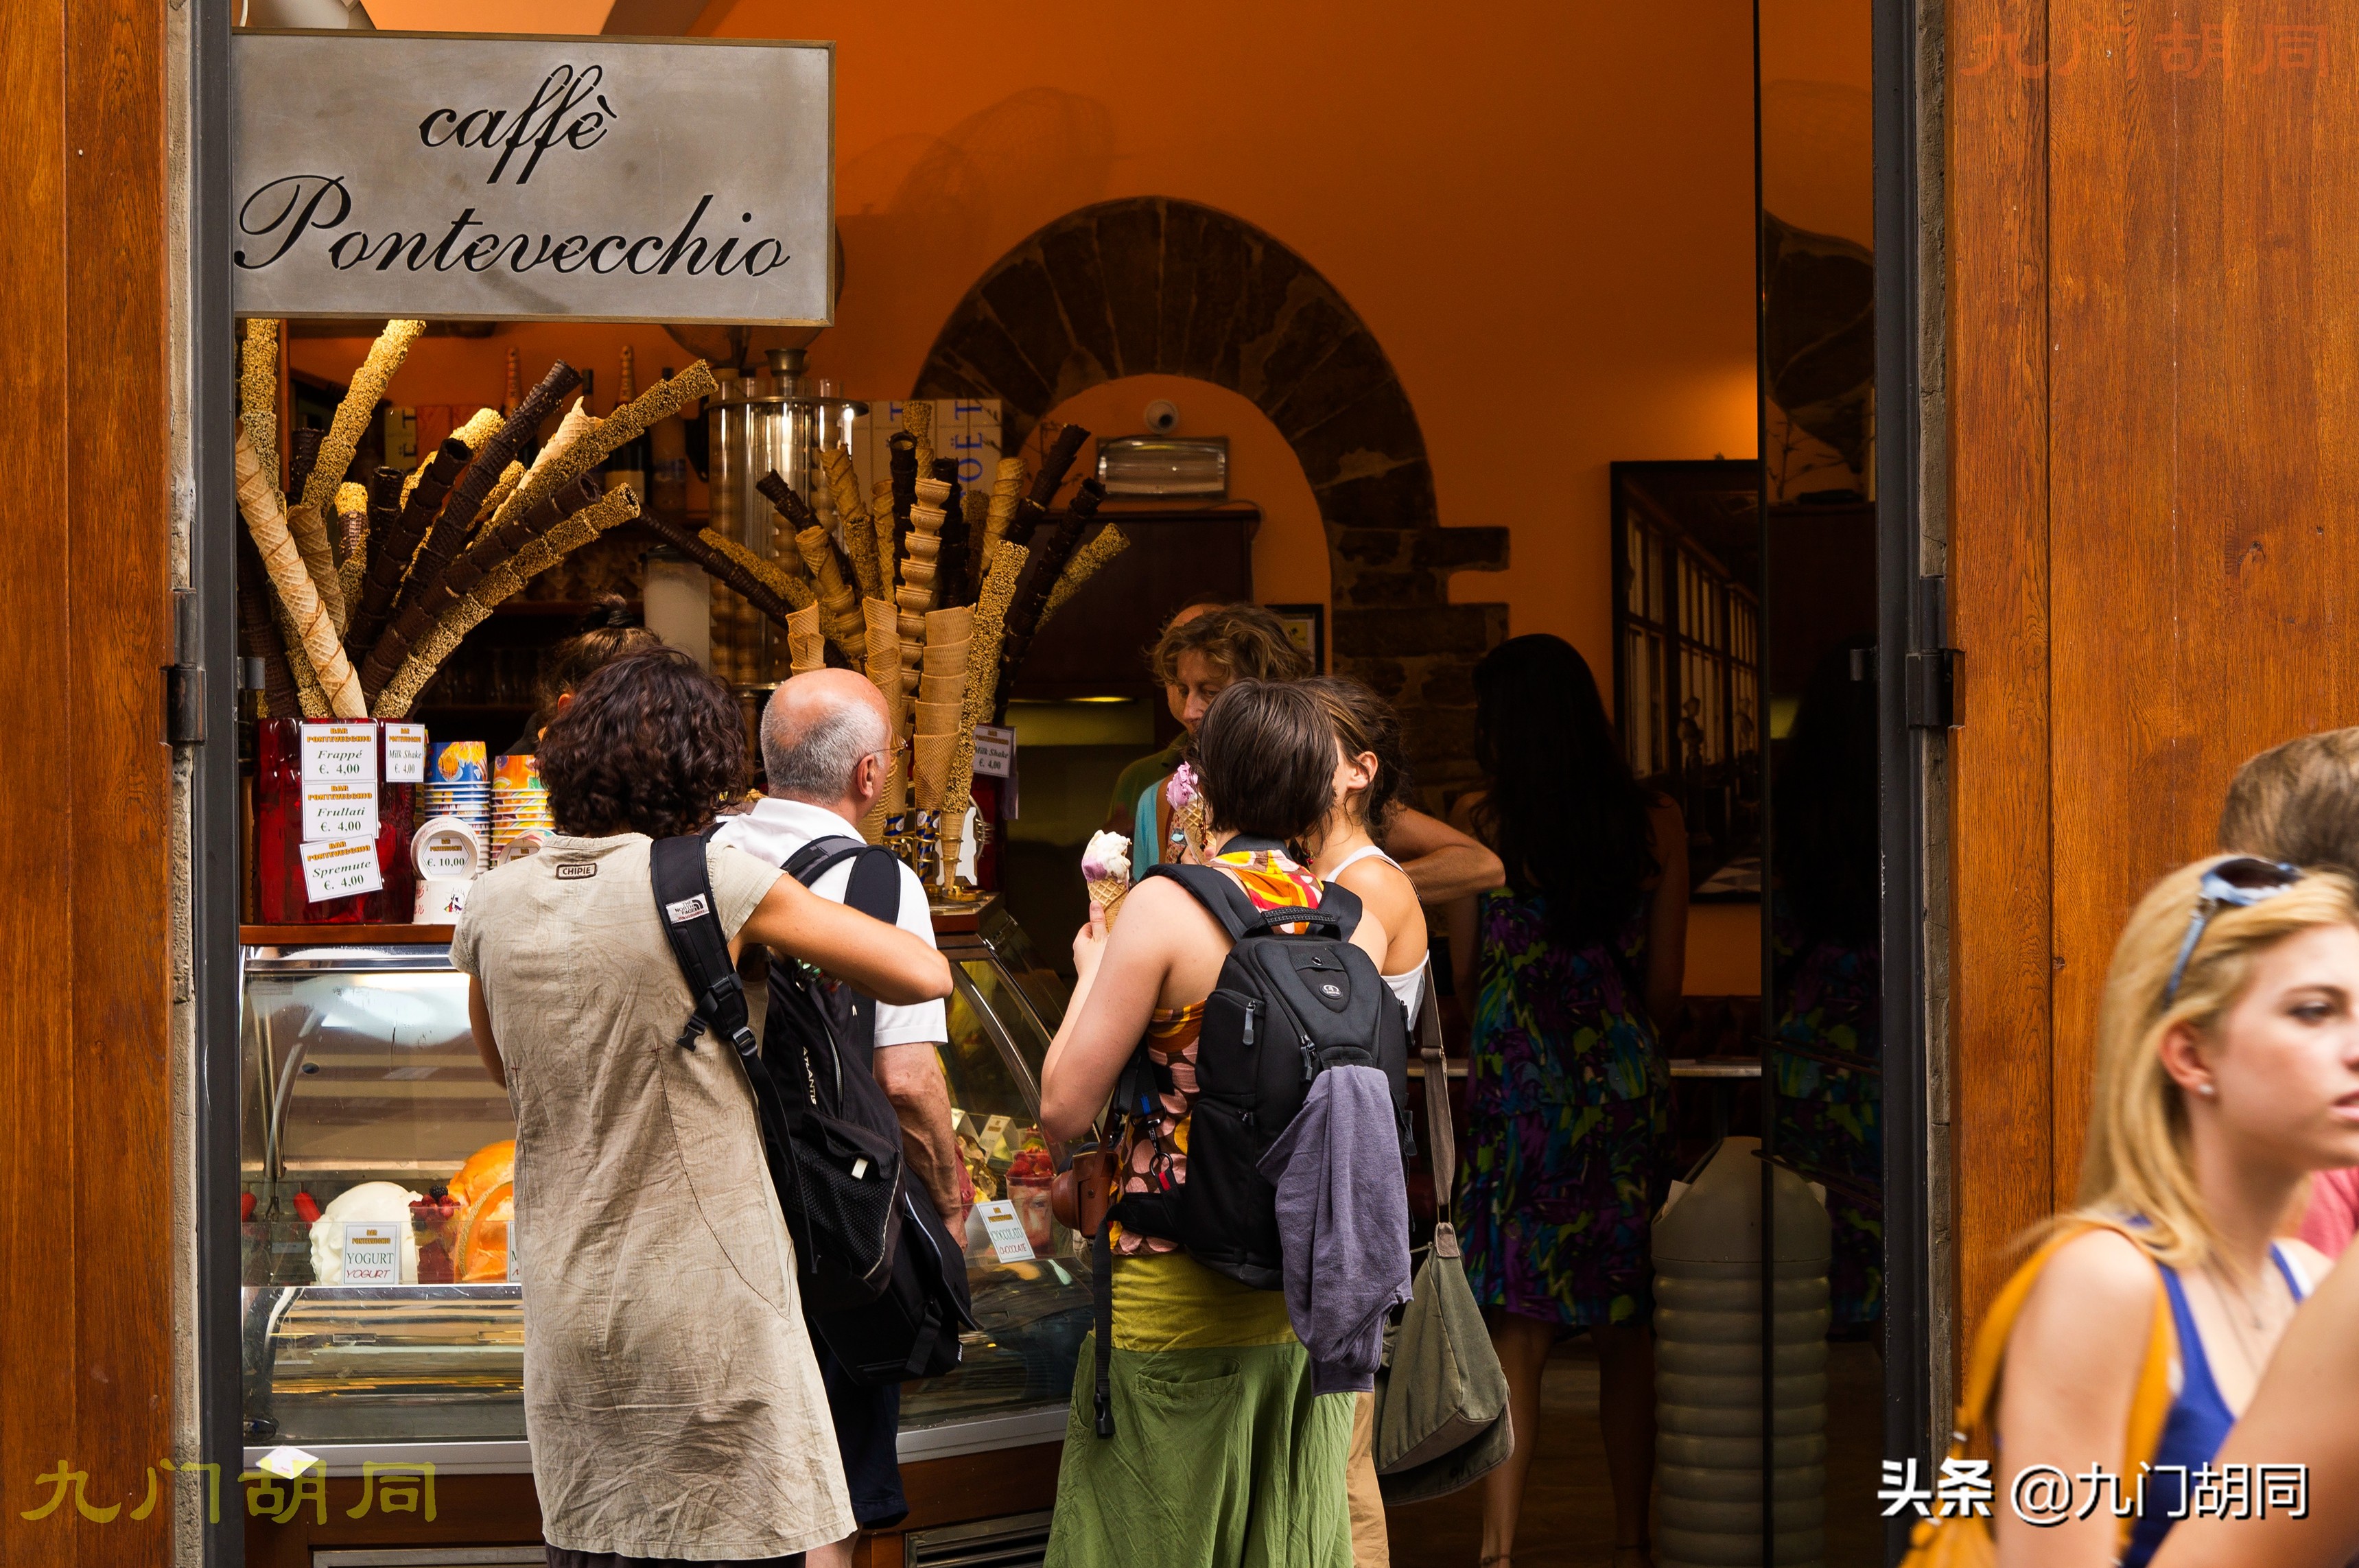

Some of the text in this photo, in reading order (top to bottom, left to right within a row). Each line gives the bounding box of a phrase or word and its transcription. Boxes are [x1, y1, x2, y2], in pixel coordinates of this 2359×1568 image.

[419, 65, 617, 185] caffè
[233, 174, 791, 277] Pontevecchio
[318, 749, 363, 761] Frappé
[388, 749, 422, 759] Milk Shake
[319, 764, 360, 775] €. 4,00
[403, 764, 415, 775] 4,00
[317, 807, 365, 817] Frullati
[320, 821, 361, 832] €. 4,00
[329, 841, 347, 850] BAR
[307, 845, 371, 862] PONTEVECCHIO
[427, 858, 465, 867] €. 10,00
[312, 861, 371, 878] Spremute
[563, 867, 591, 875] CHIPIE
[324, 874, 364, 890] €. 4,00
[674, 904, 694, 913] NORTH
[803, 1046, 817, 1105] ATLANTIS
[991, 1228, 1023, 1241] CIOCCOLATO
[999, 1243, 1026, 1254] CHOCOLATE
[347, 1252, 394, 1264] YOGURT
[347, 1269, 390, 1278] YOGURT
